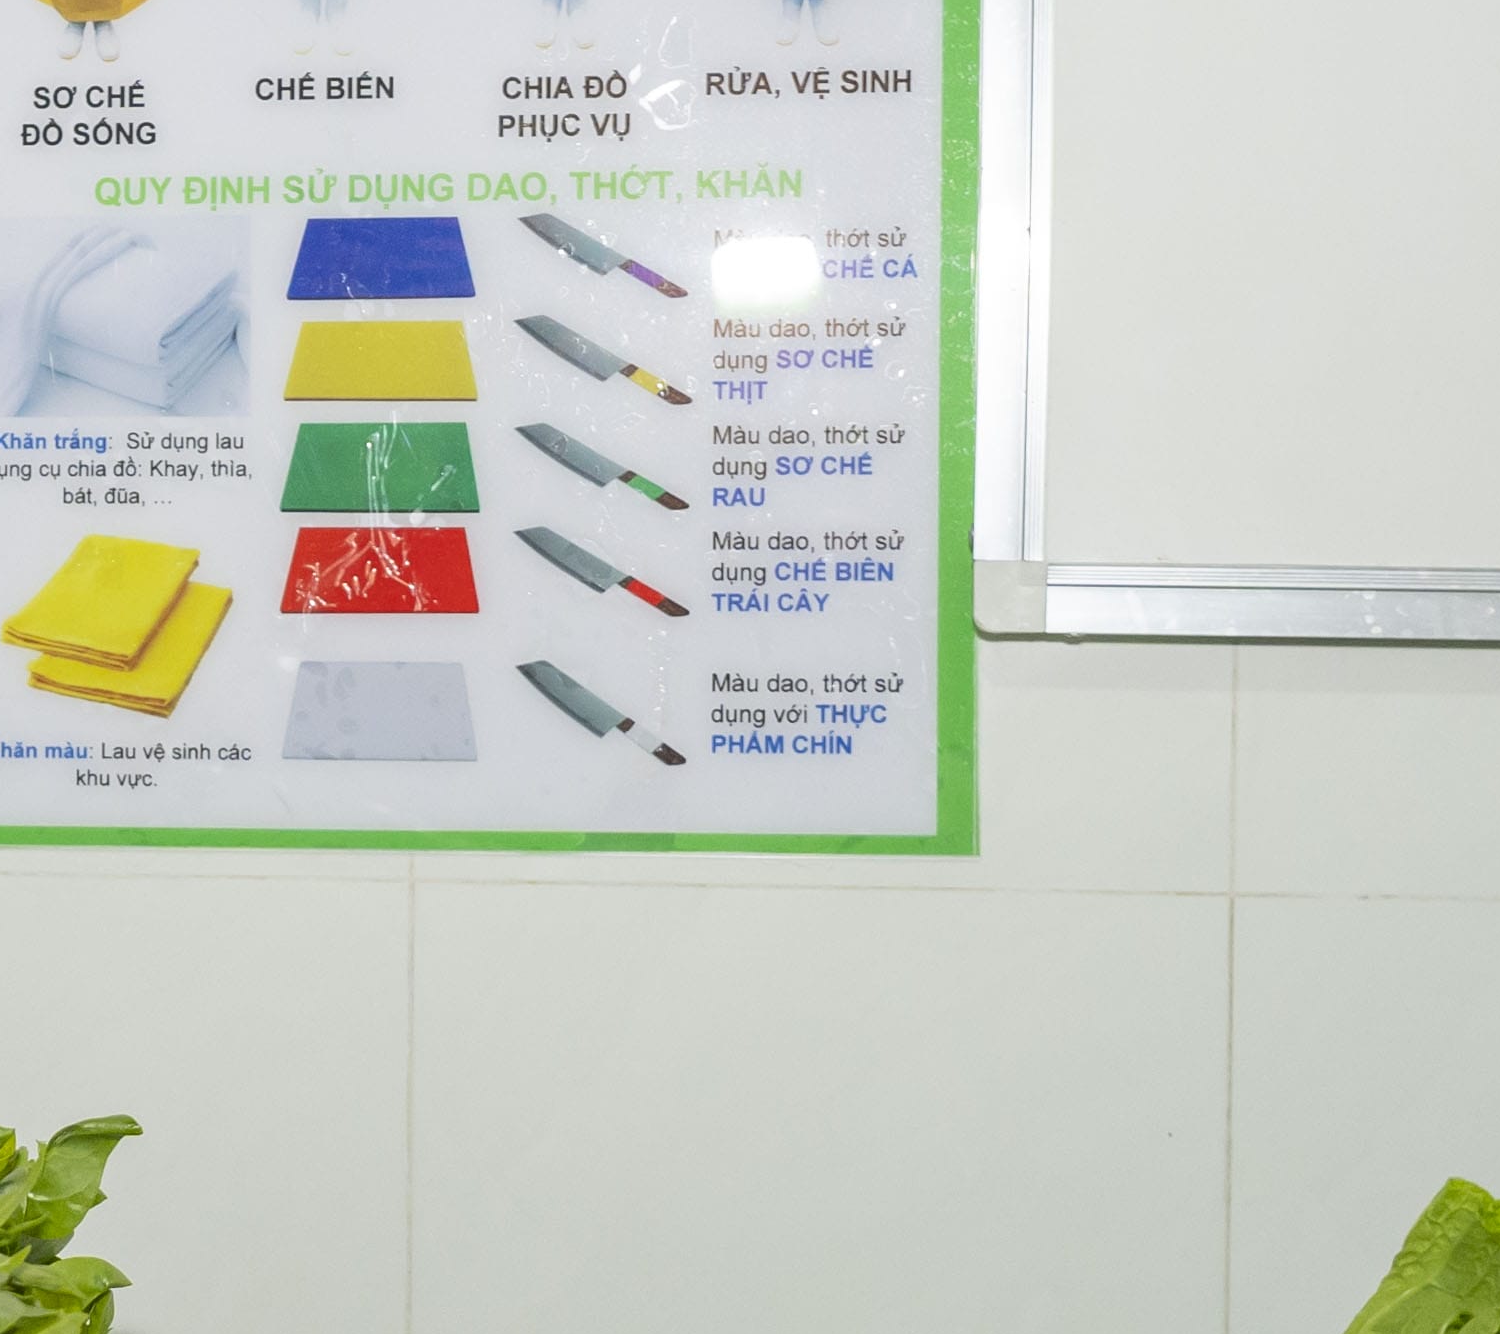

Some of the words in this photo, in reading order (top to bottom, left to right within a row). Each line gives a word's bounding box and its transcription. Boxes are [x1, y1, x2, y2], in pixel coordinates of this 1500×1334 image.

[33, 85, 77, 109] SƠ
[86, 79, 146, 108] CHẾ
[255, 72, 315, 101] CHẾ
[326, 70, 395, 100] BIẾN
[502, 76, 574, 100] CHIA
[584, 70, 628, 99] ĐỒ
[705, 67, 781, 99] RỬA,
[791, 67, 830, 99] VỆ
[841, 70, 912, 93] SINH
[21, 118, 63, 146] ĐỒ
[73, 117, 157, 146] SỐNG
[498, 113, 580, 143] PHỤC
[589, 113, 631, 142] VỤ
[95, 177, 172, 207] QUY
[183, 176, 270, 211] ĐỊNH
[283, 168, 337, 204] SỬ
[348, 174, 454, 209] DỤNG
[467, 171, 558, 205] DAO,
[570, 164, 684, 203] THỚT,
[697, 162, 803, 199] KHĂN
[826, 228, 870, 247] thớt
[878, 226, 908, 247] sử
[883, 254, 918, 278] CÁ
[54, 428, 113, 456] trắng:
[126, 432, 154, 451] Sử
[161, 432, 208, 455] dụng
[215, 432, 244, 451] lau
[713, 426, 760, 444] Màu
[769, 426, 816, 447] dao,
[824, 424, 868, 444] thớt
[876, 423, 905, 444] sử
[39, 464, 62, 482] cụ
[67, 460, 108, 478] chia
[113, 456, 142, 478] đồ:
[149, 460, 204, 482] Khay,
[211, 459, 252, 480] thìa,
[712, 457, 767, 480] dụng
[776, 455, 814, 475] SƠ
[821, 452, 873, 475] CHẾ
[63, 487, 98, 507] bát,
[104, 487, 145, 507] đũa,
[713, 487, 766, 507] RAU
[712, 531, 759, 550] Màu
[768, 532, 815, 553] dao,
[824, 531, 868, 550] thớt
[875, 529, 904, 550] sử
[712, 562, 767, 586] dụng
[775, 558, 827, 581] CHẾ
[712, 588, 769, 612] TRÁI
[777, 589, 829, 612] CÂY
[712, 673, 759, 693] Màu
[767, 673, 814, 695] dao,
[822, 673, 867, 693] thớt
[874, 672, 904, 693] sử
[711, 704, 766, 728] dụng
[774, 704, 808, 724] với
[816, 704, 887, 729] THỰC
[45, 741, 93, 760] màu:
[102, 742, 136, 760] Lau
[143, 742, 166, 766] vệ
[172, 742, 211, 760] sinh
[218, 742, 251, 760] các
[792, 732, 852, 754] CHÍN
[76, 768, 110, 787] khu
[117, 770, 158, 792] vực.
